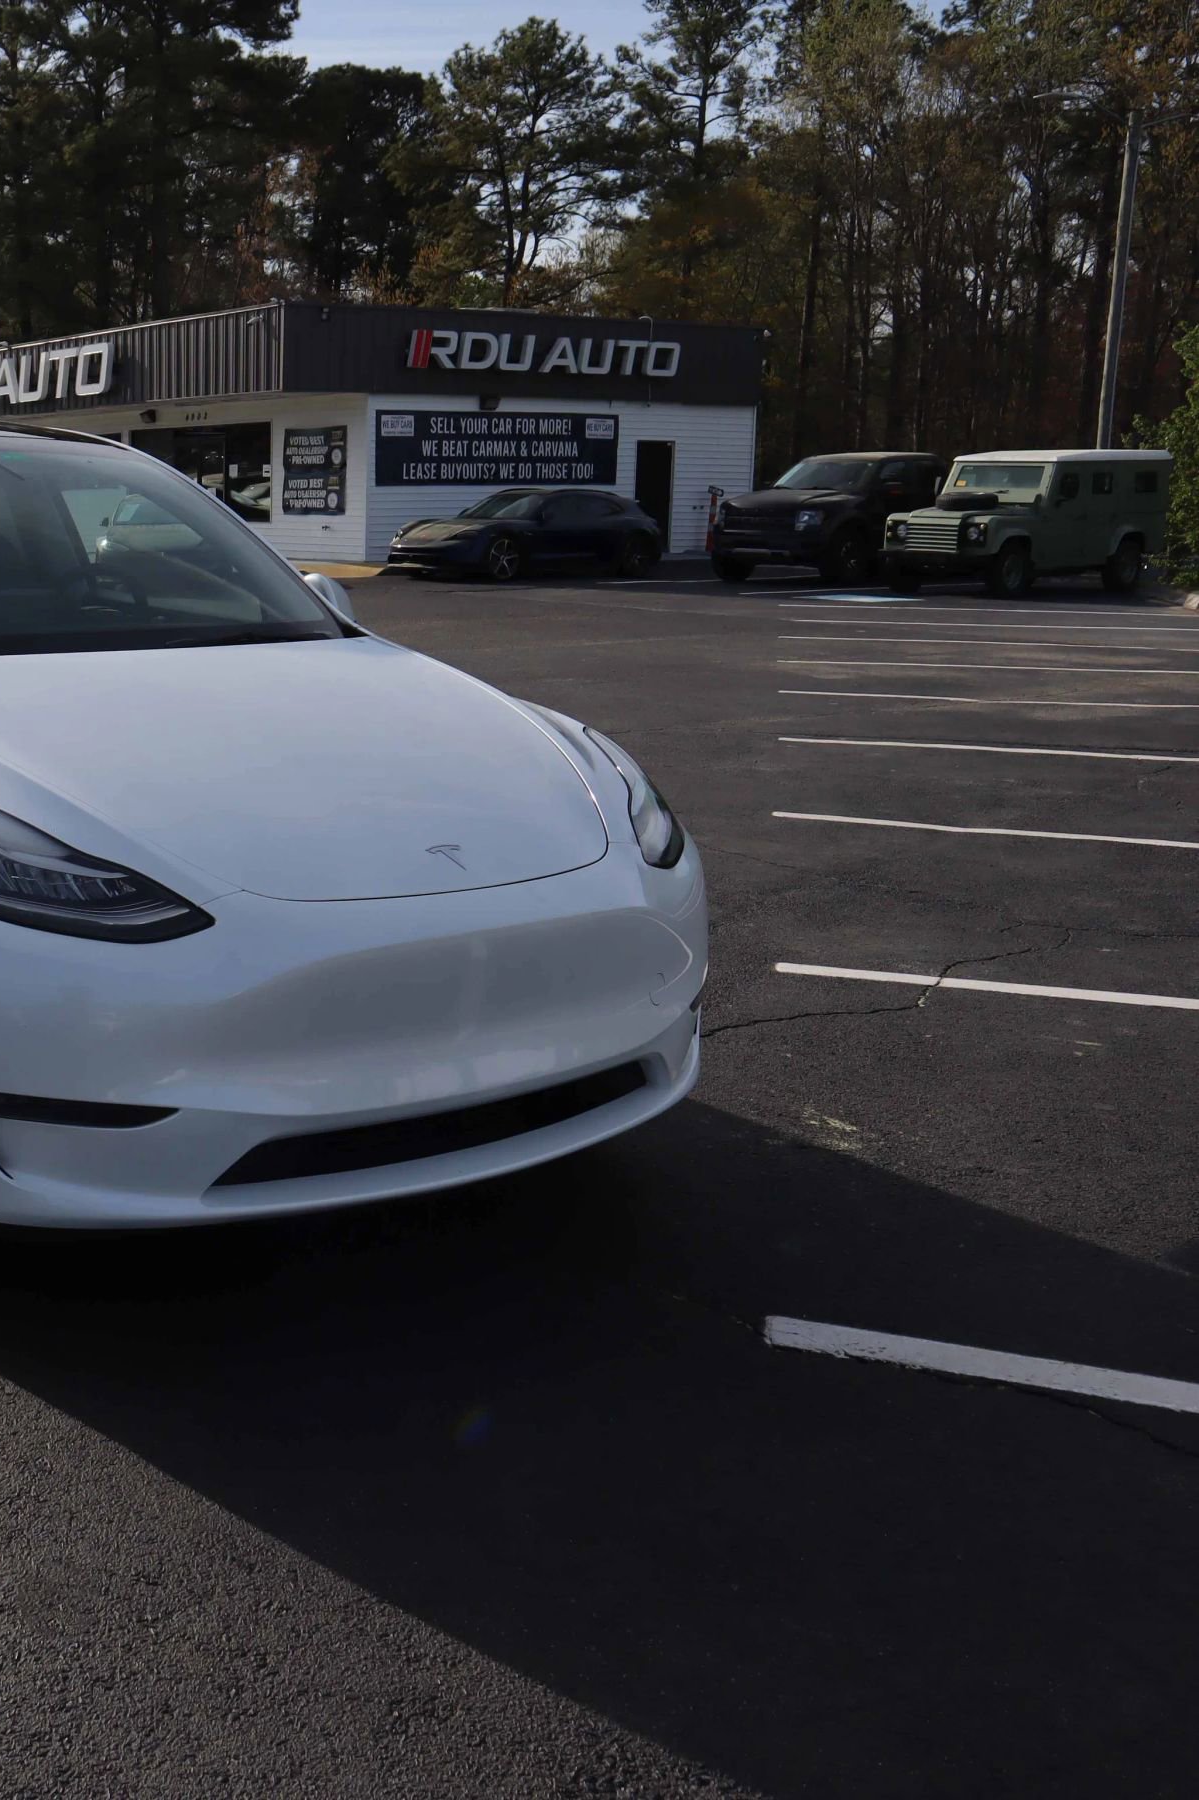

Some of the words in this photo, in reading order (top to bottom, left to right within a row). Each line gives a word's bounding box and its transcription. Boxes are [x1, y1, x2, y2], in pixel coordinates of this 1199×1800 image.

[428, 330, 536, 371] RDU
[538, 337, 681, 377] AUTO
[430, 417, 456, 434] SELL
[461, 417, 488, 434] YOUR
[491, 418, 512, 434] CAR
[516, 418, 536, 435] FOR
[539, 418, 572, 435] MORE!
[422, 440, 438, 457] WE
[442, 440, 468, 457] BEAT
[472, 441, 517, 457] CARMAX
[521, 441, 528, 457] &
[531, 441, 578, 457] CARVANA
[403, 463, 437, 480] LEASE
[441, 463, 496, 480] BUYOUTS?
[499, 463, 515, 479] WE
[518, 463, 532, 479] DO
[536, 463, 567, 479] THOSE
[572, 463, 594, 479] TOO!
